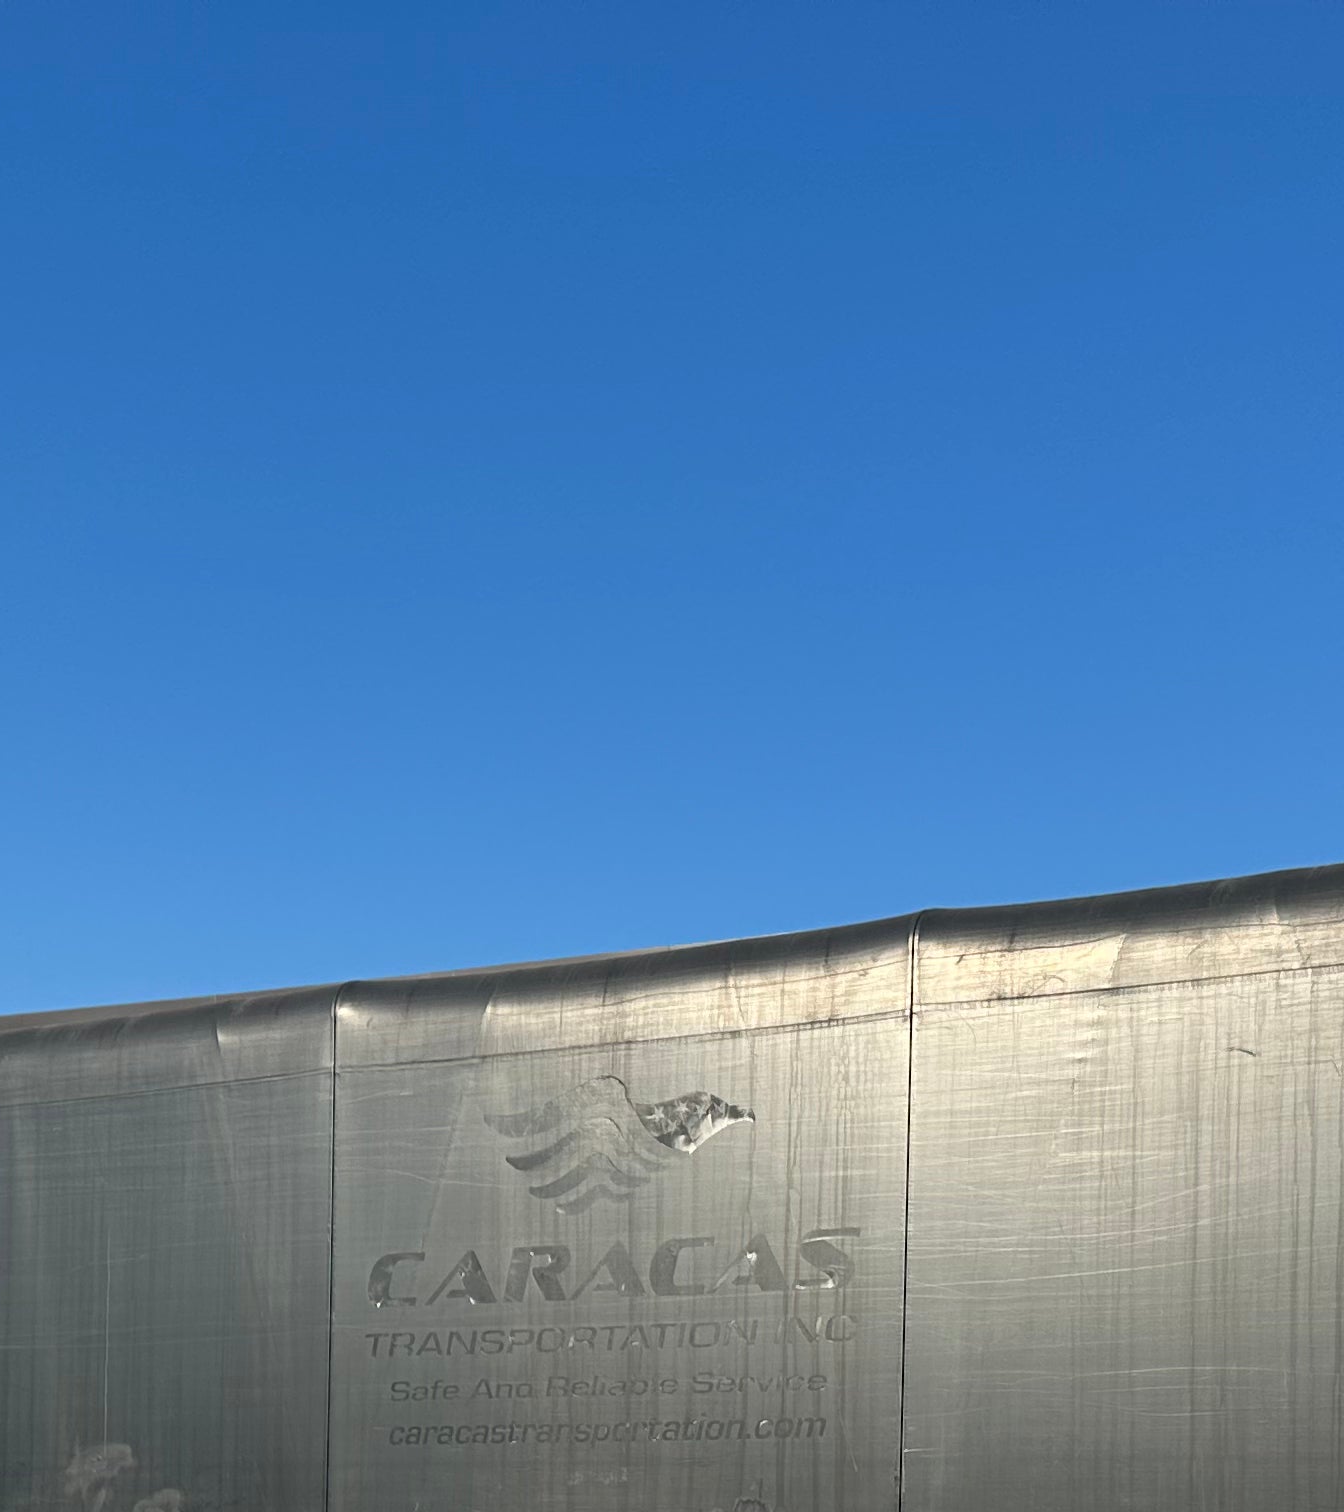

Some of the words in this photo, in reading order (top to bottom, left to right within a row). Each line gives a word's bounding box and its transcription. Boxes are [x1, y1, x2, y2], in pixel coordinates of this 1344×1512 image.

[367, 1227, 862, 1307] CARACAS
[364, 1318, 759, 1358] TRANSPORTATION
[773, 1314, 858, 1345] INC
[390, 1378, 460, 1402] Safe
[692, 1371, 828, 1394] Service
[388, 1411, 828, 1449] caracastransportation.com
